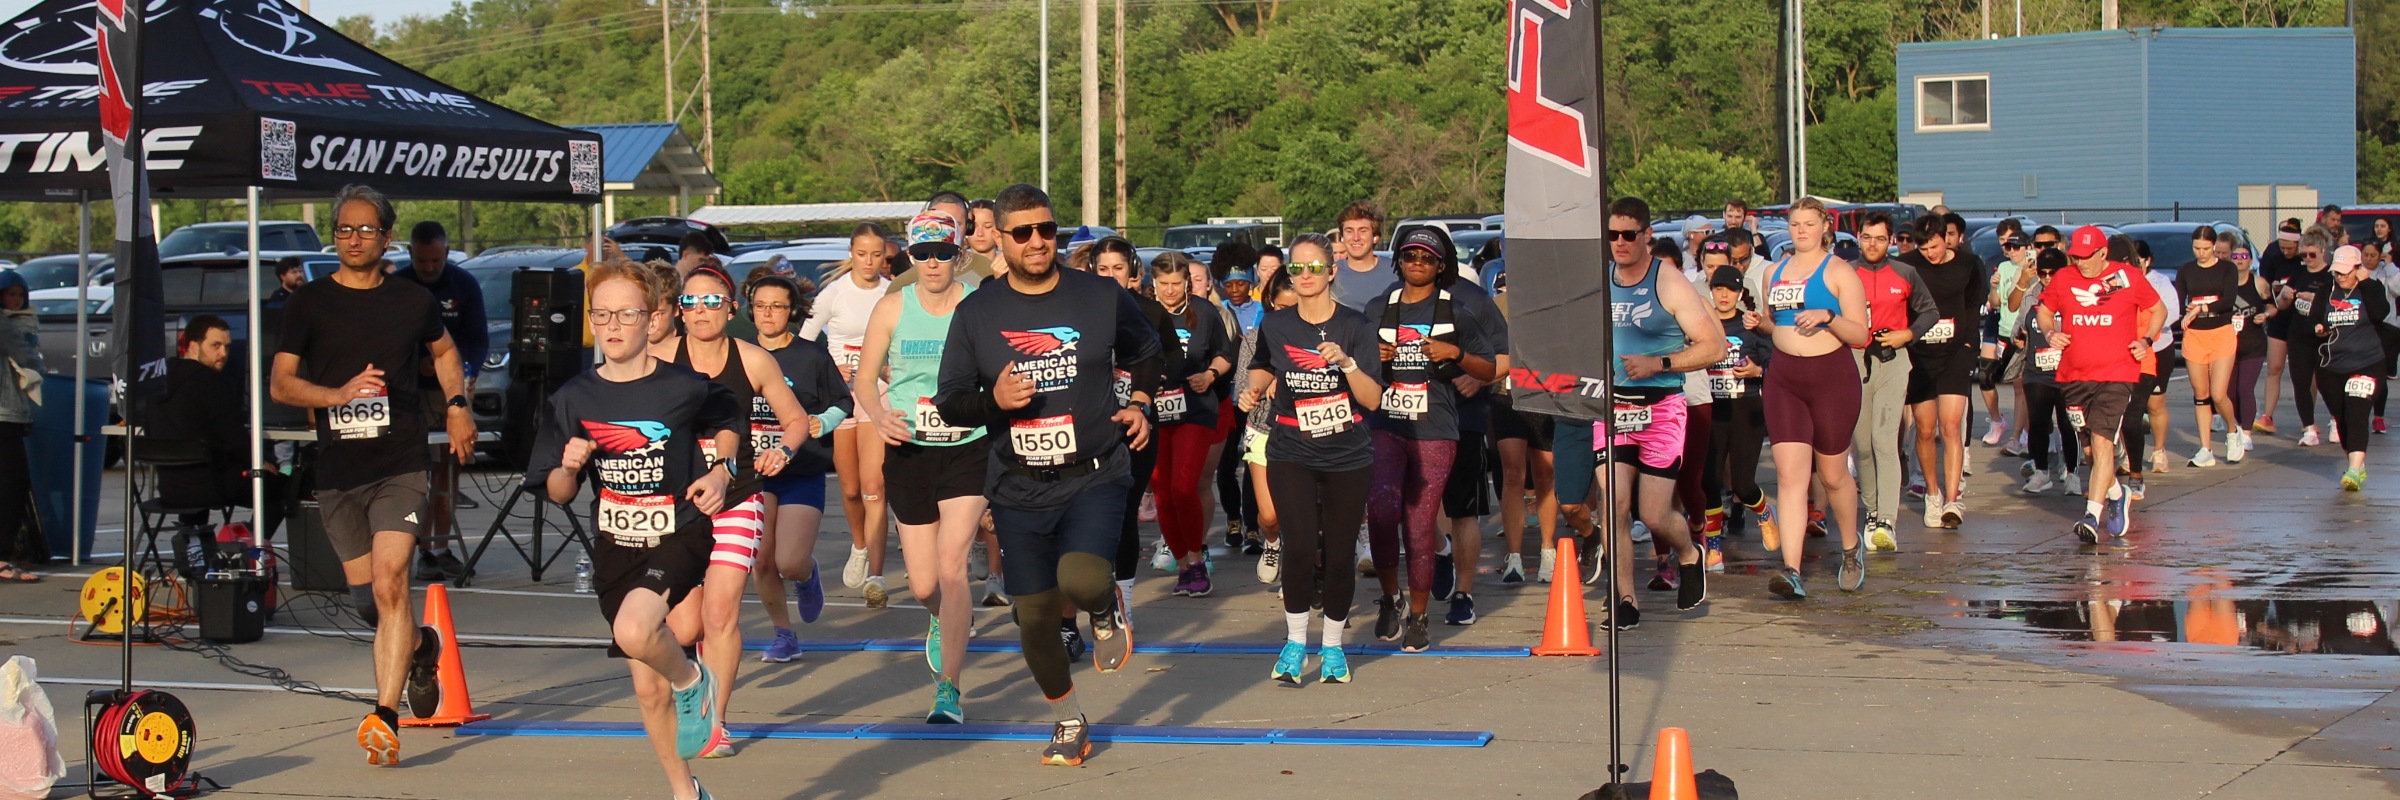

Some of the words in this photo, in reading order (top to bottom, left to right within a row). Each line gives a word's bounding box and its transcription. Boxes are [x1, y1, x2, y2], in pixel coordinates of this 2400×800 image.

[302, 135, 386, 174] SCAN
[385, 142, 447, 177] FOR
[446, 145, 566, 183] RESULTS
[1772, 287, 1802, 302] 1537
[2072, 314, 2113, 327] RWB
[1926, 326, 1952, 339] 593
[1285, 371, 1339, 383] AMERICAN
[1285, 379, 1339, 390] HEROES
[1510, 367, 1579, 393] RUE
[2346, 380, 2373, 392] 1614
[1155, 397, 1182, 413] 607
[1384, 391, 1424, 410] 1667
[331, 401, 385, 425] 1668
[1301, 404, 1348, 427] 1546
[1617, 410, 1649, 422] 478
[1015, 431, 1071, 452] 1550
[595, 455, 664, 471] AMERICAN
[604, 508, 669, 532] 1620
